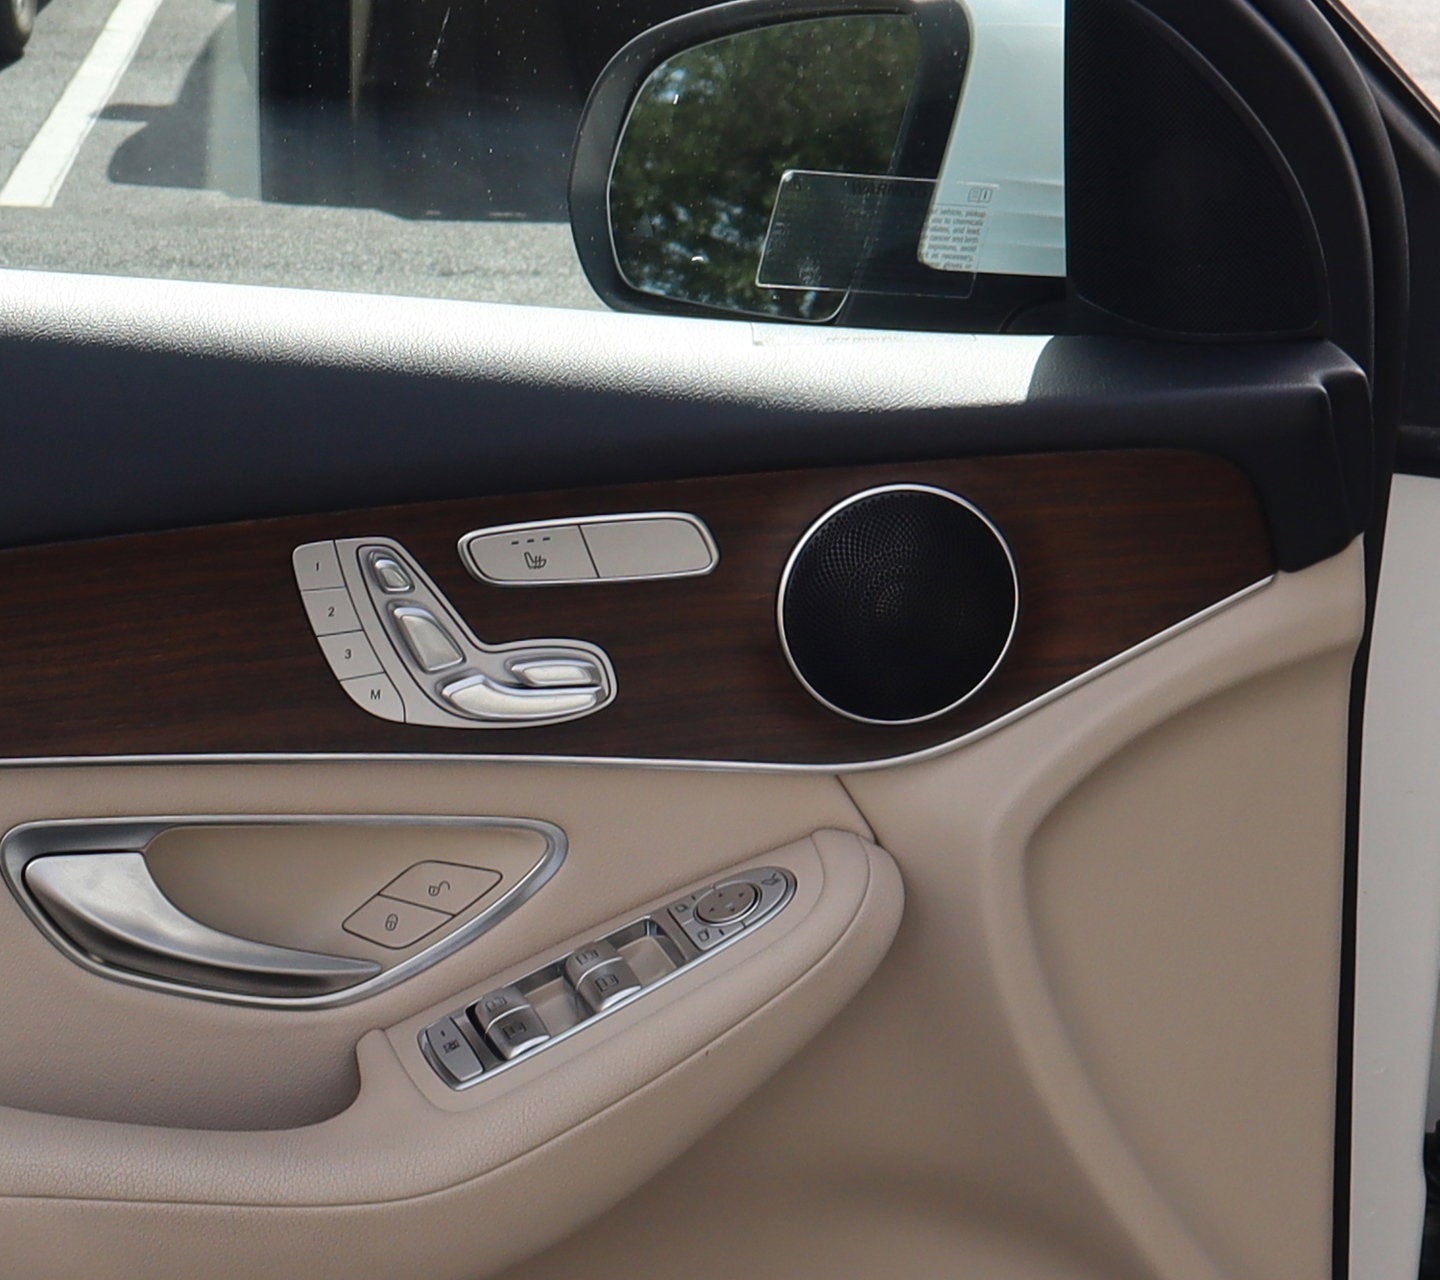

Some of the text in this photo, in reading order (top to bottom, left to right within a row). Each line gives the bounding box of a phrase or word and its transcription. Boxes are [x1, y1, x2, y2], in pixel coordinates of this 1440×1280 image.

[328, 606, 335, 617] 2
[345, 649, 352, 659] 3
[370, 689, 381, 700] M
